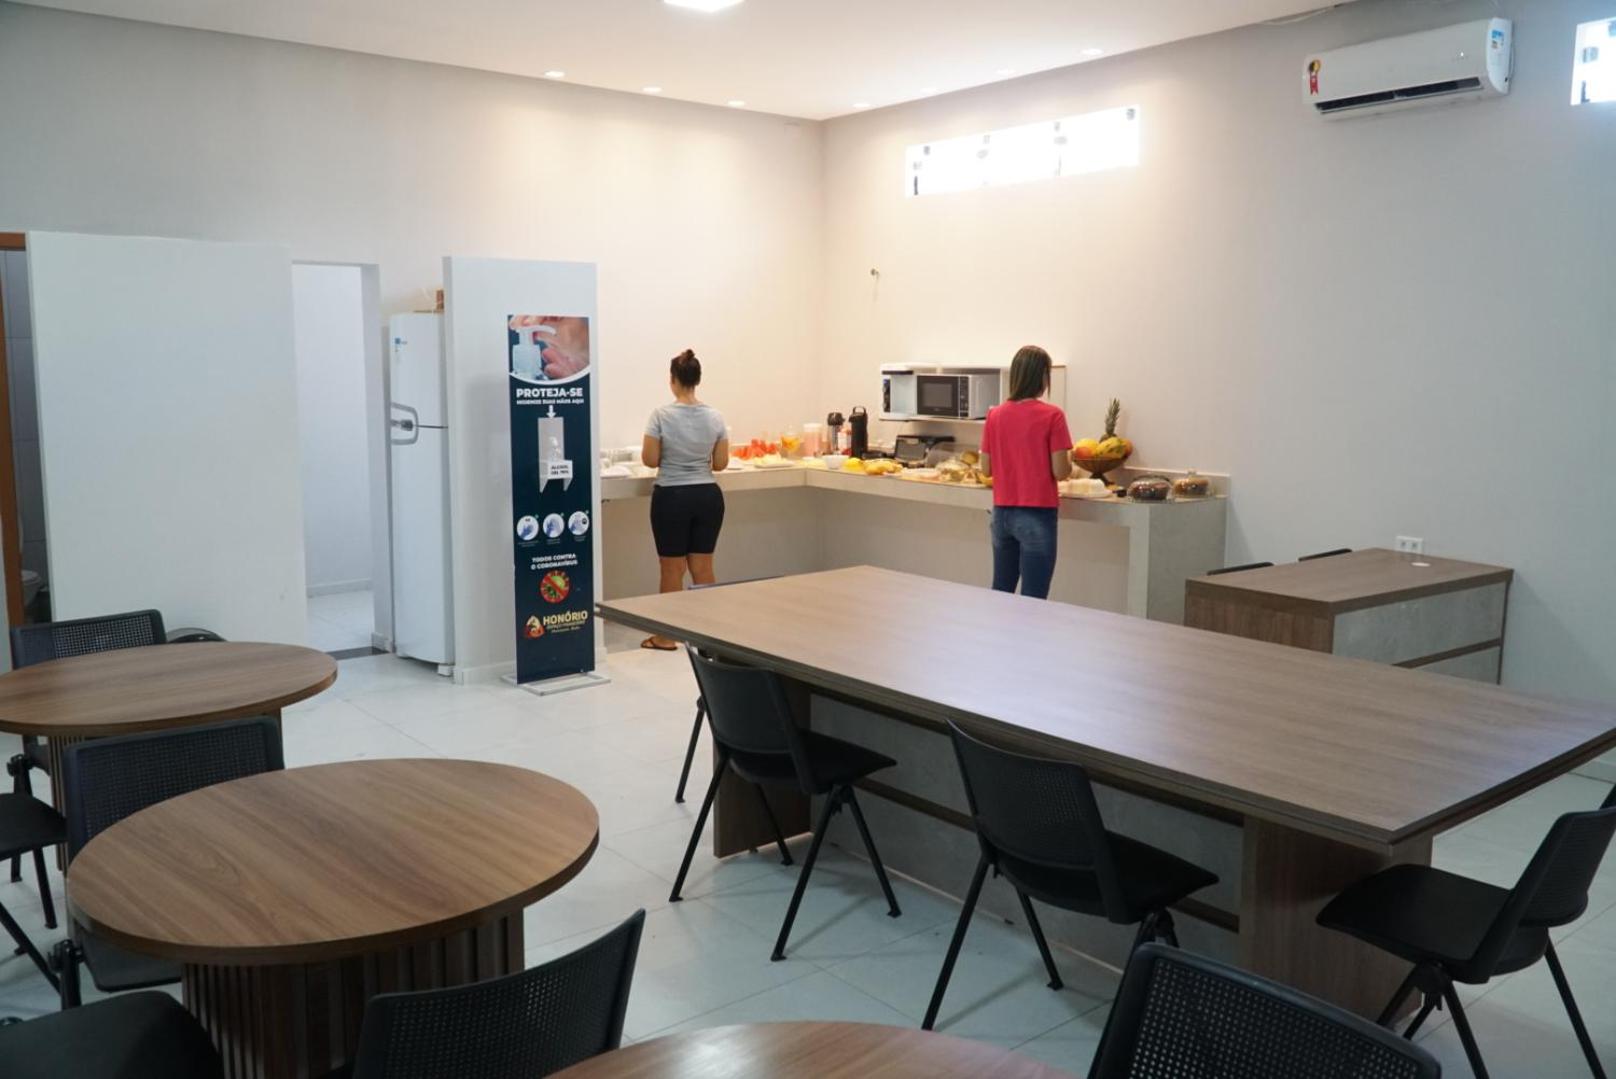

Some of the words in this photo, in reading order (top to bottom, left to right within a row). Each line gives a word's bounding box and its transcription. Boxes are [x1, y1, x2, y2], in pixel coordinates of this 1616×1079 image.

[516, 387, 583, 398] PROTEJA-SE
[552, 553, 576, 561] CONTRA
[543, 610, 588, 625] HONÓRIO
